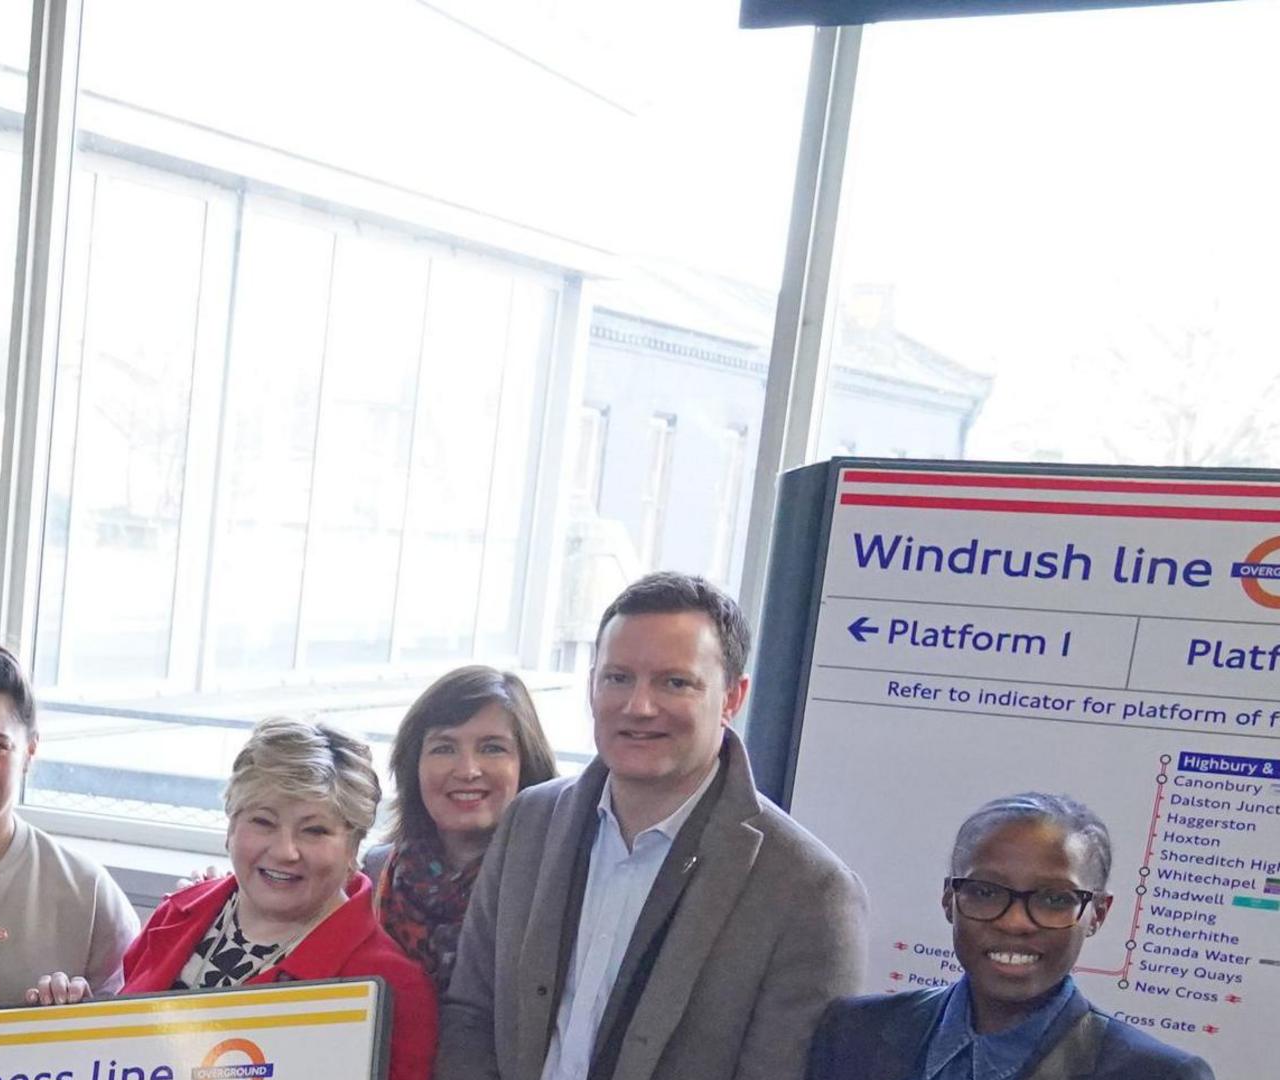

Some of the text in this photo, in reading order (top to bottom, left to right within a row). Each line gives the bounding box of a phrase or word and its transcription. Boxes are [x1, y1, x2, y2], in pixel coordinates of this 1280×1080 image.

[854, 533, 1212, 587] Windrush line
[1240, 565, 1280, 577] OVERG
[888, 619, 1045, 655] Platform
[1187, 639, 1280, 672] Platf
[887, 680, 940, 701] Refer
[948, 687, 970, 703] to
[978, 689, 1075, 712] indicator
[1083, 696, 1115, 715] for
[1122, 701, 1226, 725] platform
[1236, 708, 1261, 726] of
[1184, 755, 1274, 775] Highbury &
[1174, 775, 1263, 796] Canonbury
[1170, 794, 1280, 815] Dalston Junct
[1167, 812, 1256, 831] Haggerston
[1163, 831, 1220, 847] Hoxton
[1160, 849, 1245, 869] Shoreditch
[1157, 868, 1256, 890] Whitechapel
[1153, 886, 1225, 905] Shadwell
[1150, 904, 1217, 925] Wapping
[1146, 923, 1239, 945] Rotherhithe
[914, 943, 956, 958] Quee
[1143, 942, 1251, 965] Canada Water
[909, 973, 949, 986] Peckh
[1139, 960, 1243, 984] Surrey Quays
[1135, 981, 1218, 1002] New Cross
[1160, 1017, 1196, 1032] Gate
[197, 1066, 268, 1080] OVERGROUND
